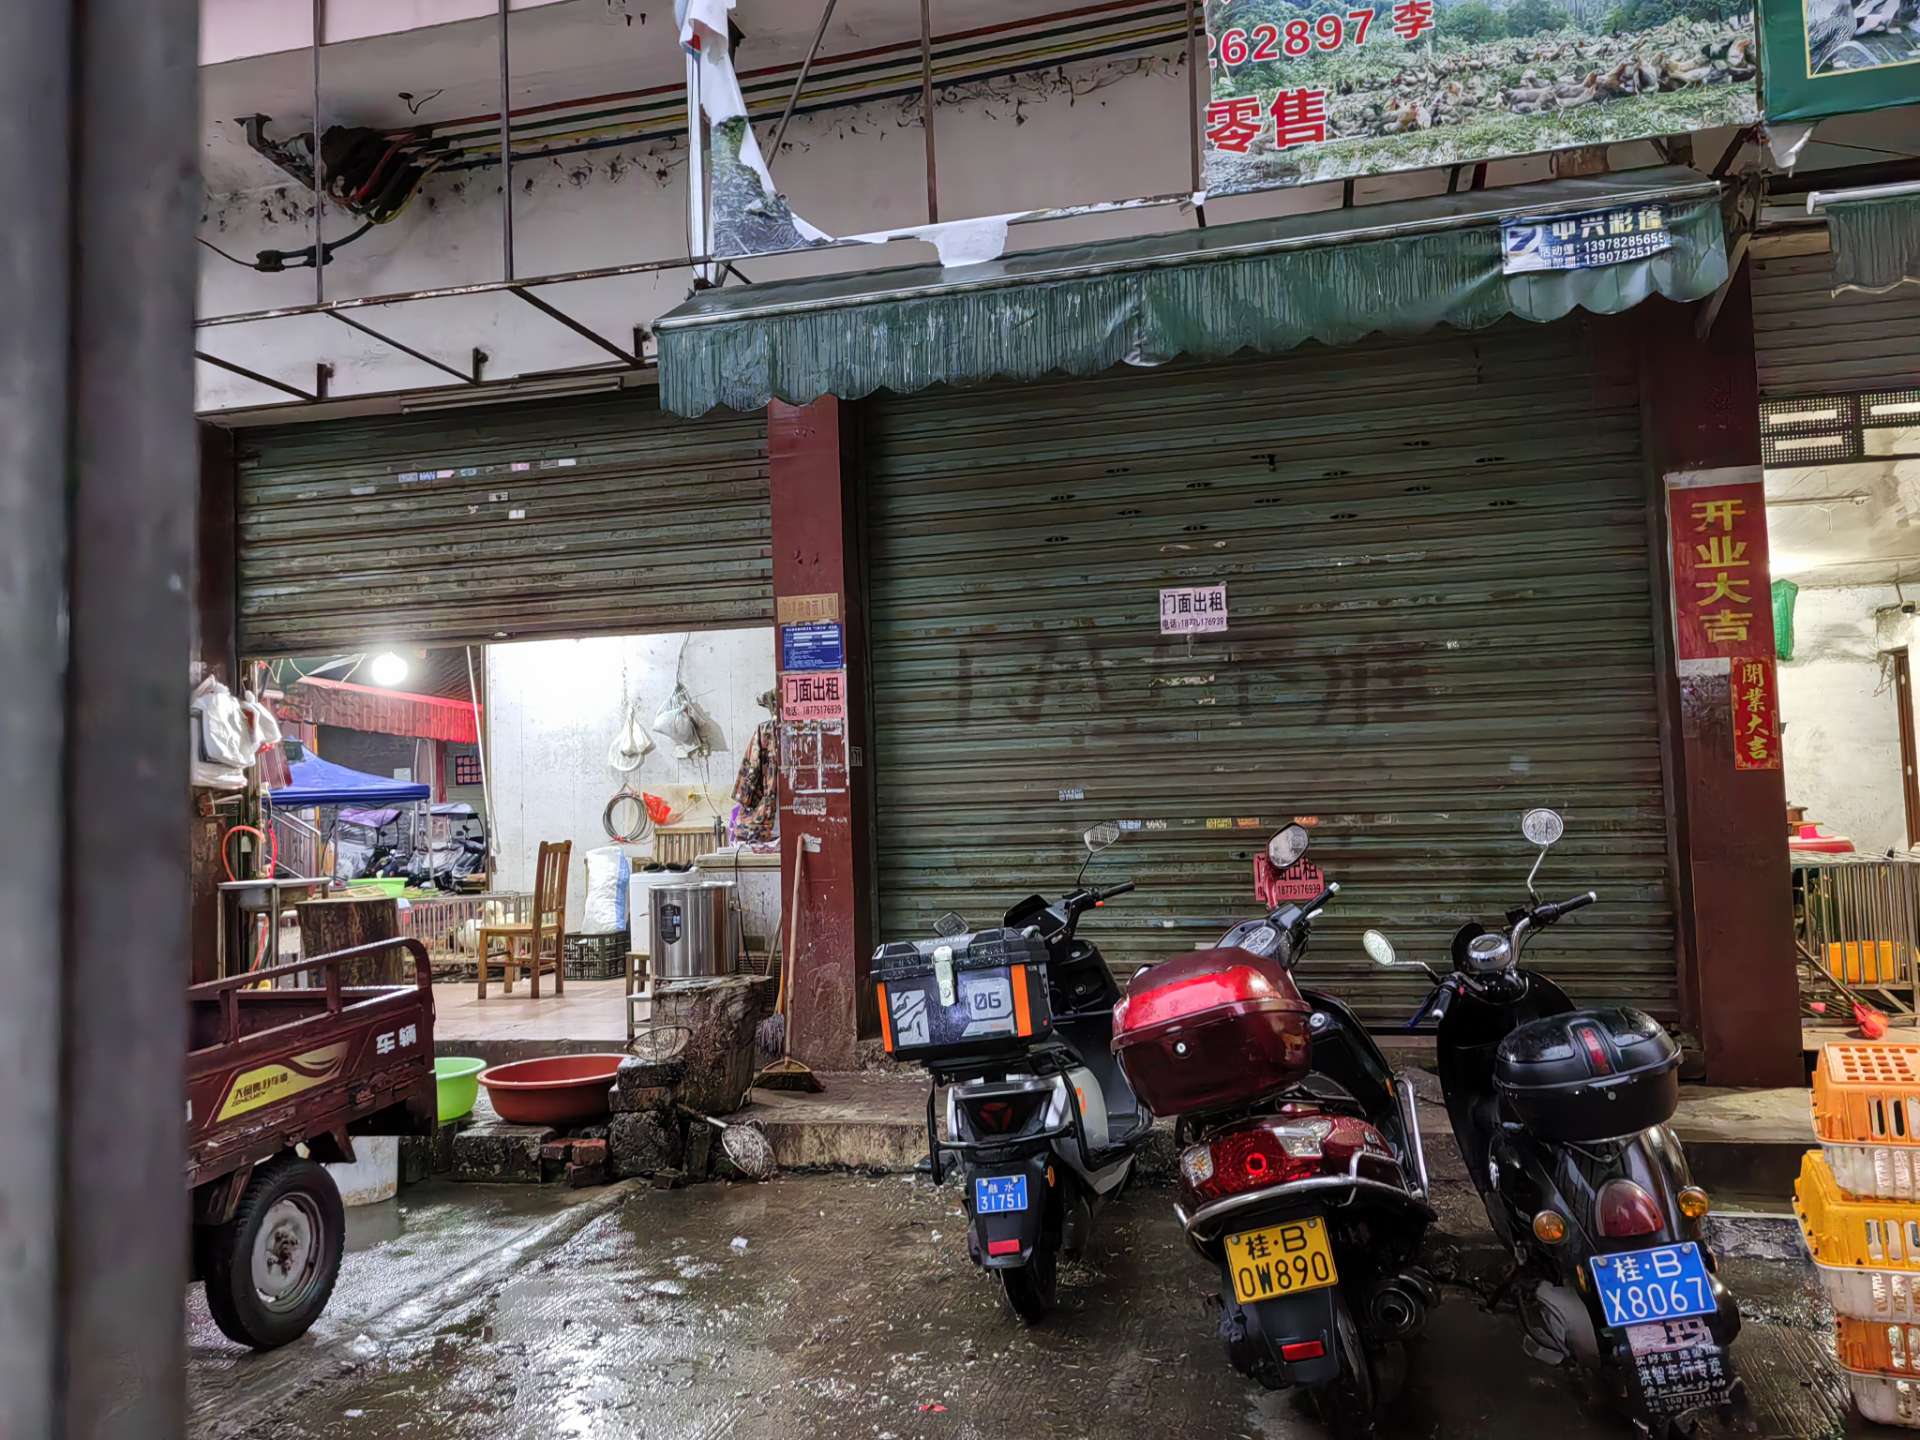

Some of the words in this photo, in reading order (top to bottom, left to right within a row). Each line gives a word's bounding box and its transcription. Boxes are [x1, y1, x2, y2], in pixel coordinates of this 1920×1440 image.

[1393, 0, 1434, 40] 李
[1206, 87, 1327, 153] 零售
[1691, 499, 1753, 642] 开业大吉
[1162, 591, 1223, 615] 门面出租
[786, 677, 840, 703] 门面出租
[1742, 663, 1769, 760] 開業大吉
[973, 991, 1002, 1011] 06
[375, 1023, 417, 1056] 车辆
[981, 1193, 1021, 1211] 31751
[1245, 1225, 1308, 1261] 桂·B
[1239, 1251, 1330, 1298] 0W890
[1613, 1249, 1682, 1284] 桂·B
[1605, 1277, 1705, 1322] X8067
